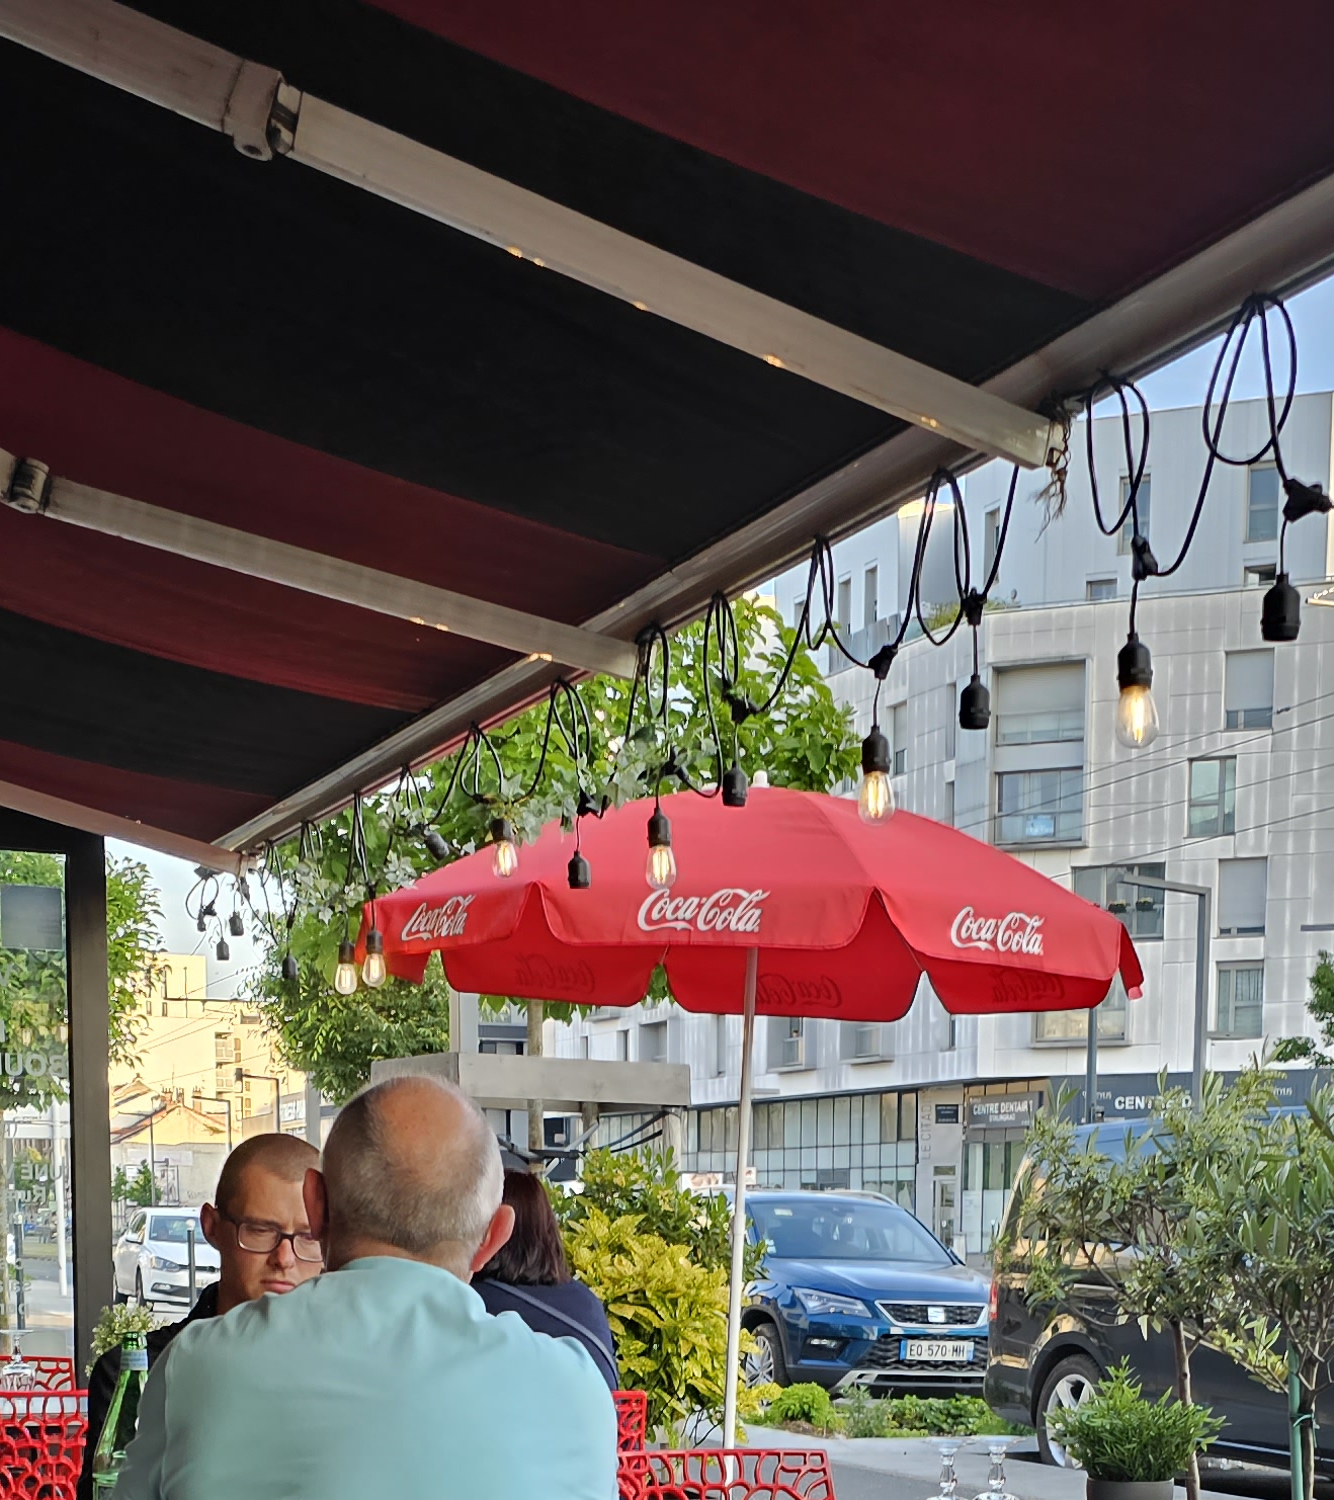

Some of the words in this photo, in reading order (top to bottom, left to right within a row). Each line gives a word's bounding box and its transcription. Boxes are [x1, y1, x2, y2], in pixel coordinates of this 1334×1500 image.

[401, 894, 477, 941] Coca-Cola
[637, 888, 771, 932] Coca-Cola
[951, 906, 1045, 956] Coca-Cola
[973, 1102, 1000, 1116] CENTRE
